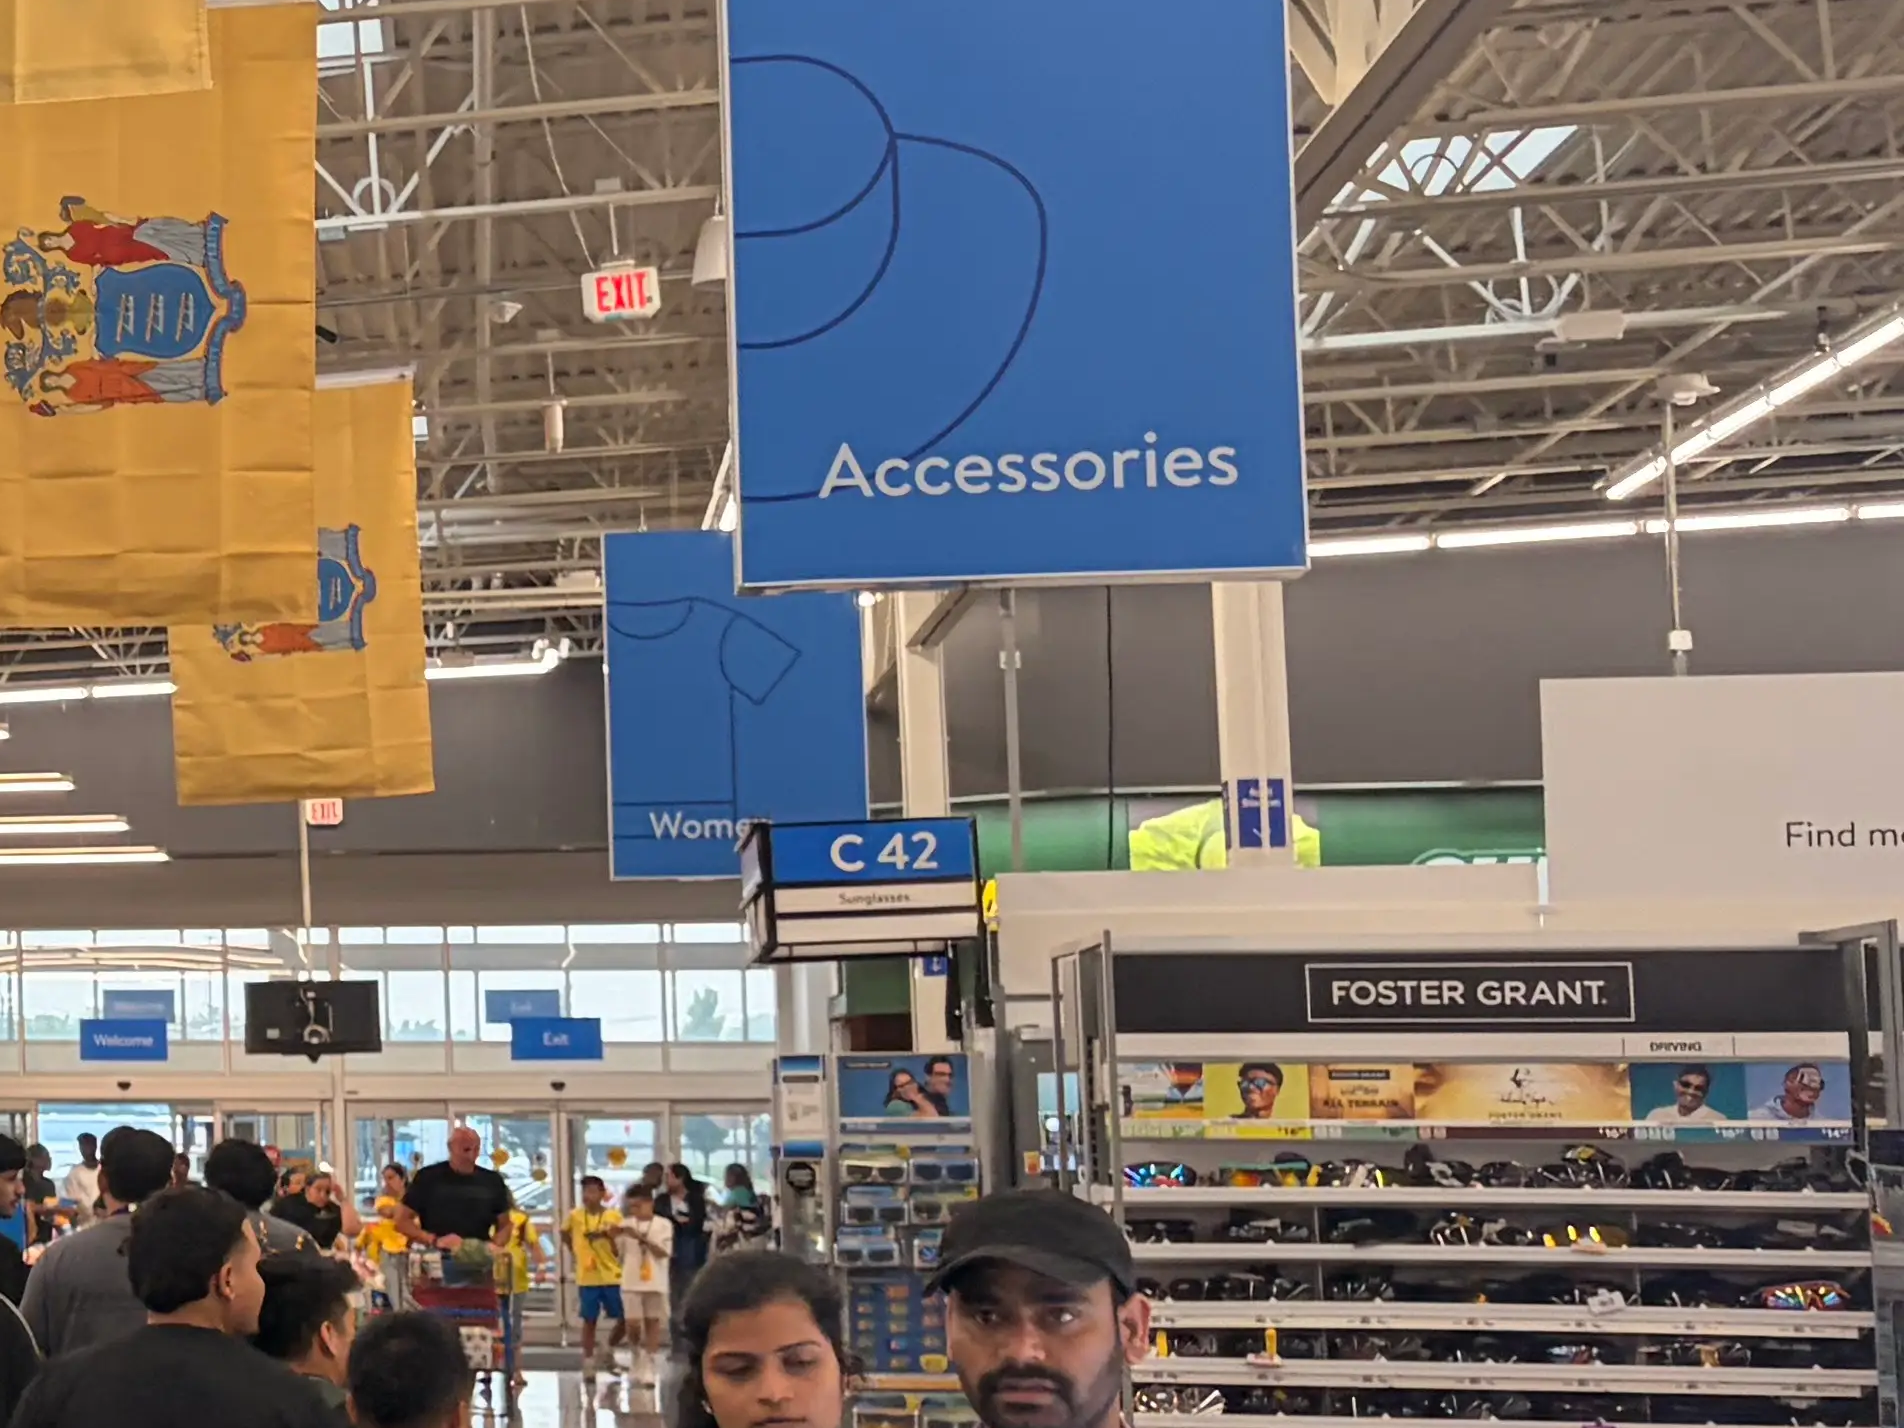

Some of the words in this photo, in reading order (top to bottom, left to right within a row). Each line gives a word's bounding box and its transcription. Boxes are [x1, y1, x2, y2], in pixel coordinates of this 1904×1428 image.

[596, 273, 648, 313] EXIT
[819, 431, 1239, 500] Accessories
[1786, 821, 1855, 848] Find
[830, 833, 865, 872] C
[877, 830, 938, 870] 42
[839, 891, 911, 907] Sunglasses
[1331, 979, 1465, 1007] FOSTER
[94, 1032, 154, 1048] Welcome
[542, 1032, 569, 1048] Exit
